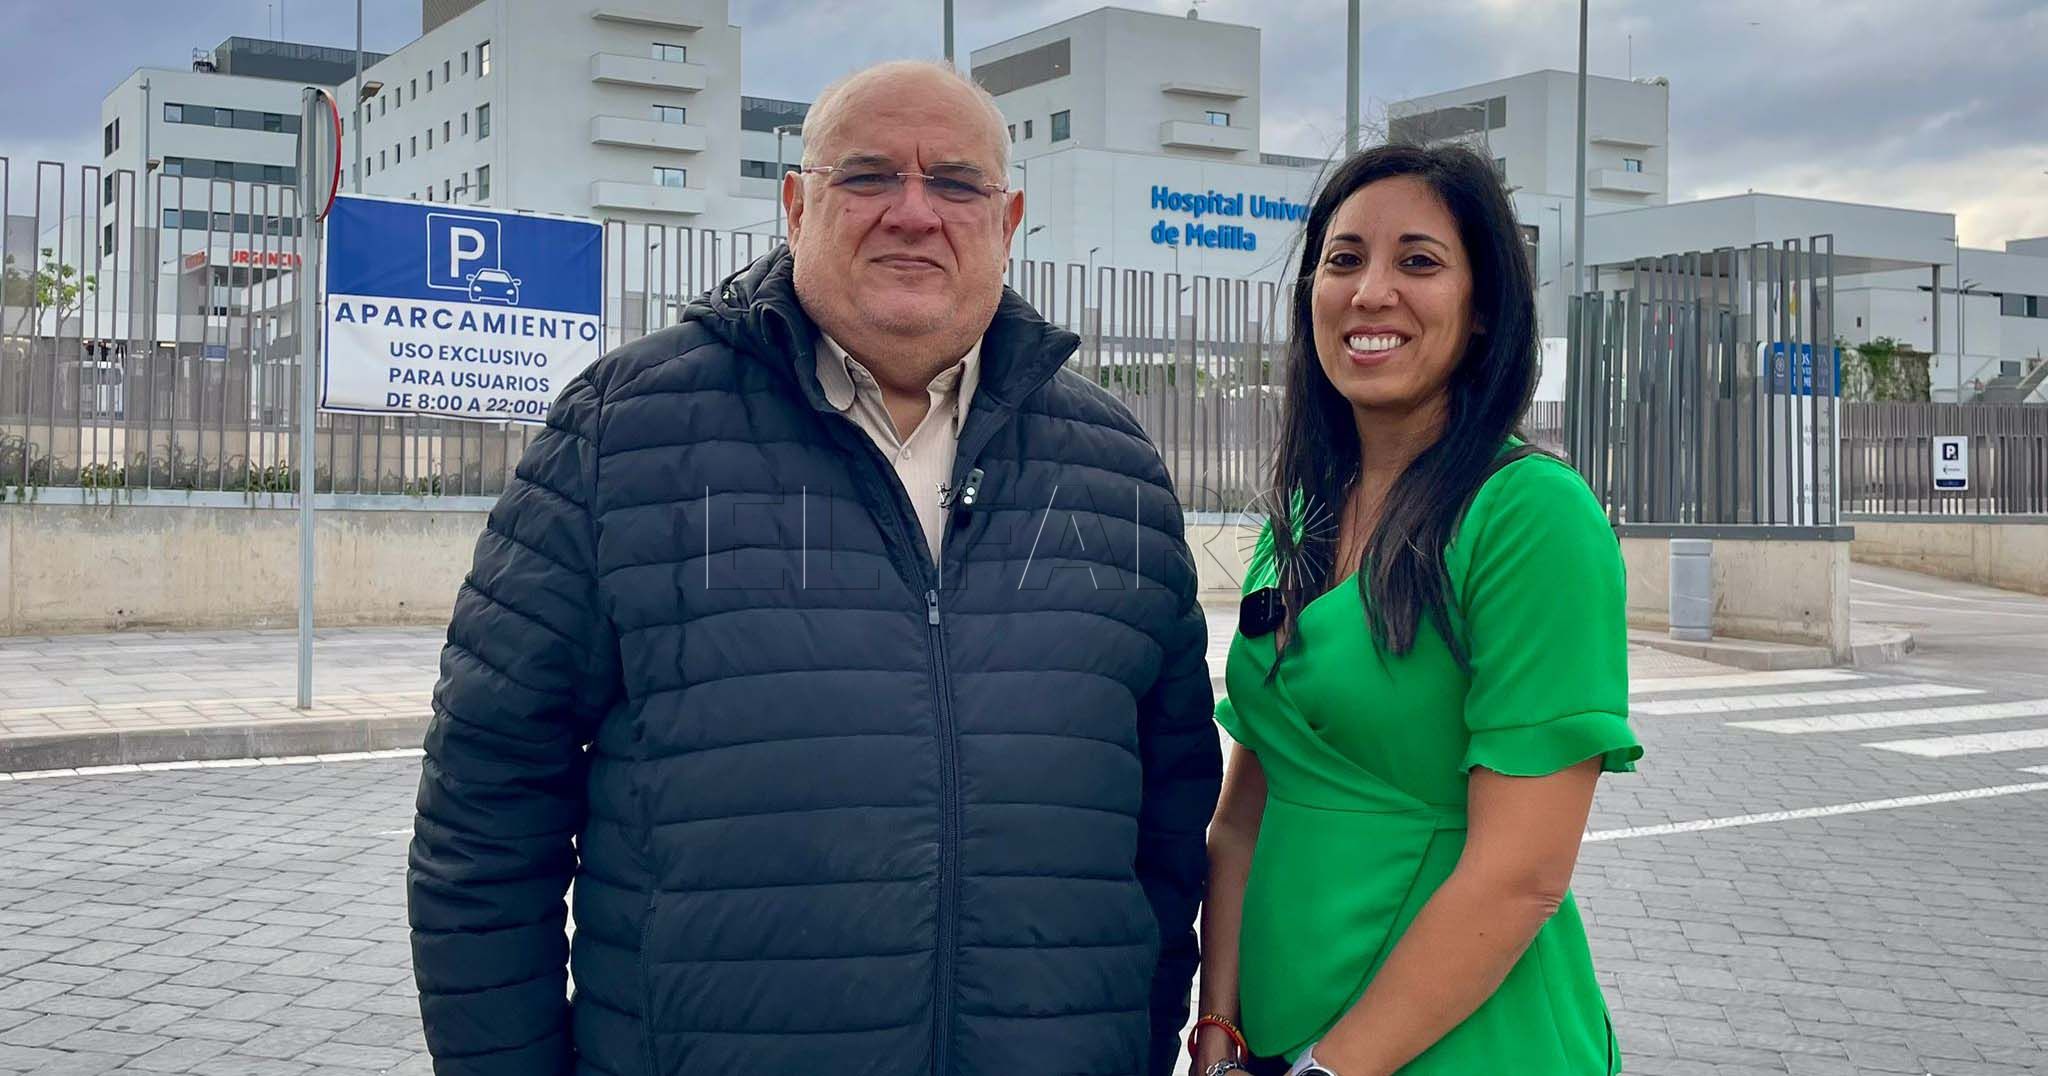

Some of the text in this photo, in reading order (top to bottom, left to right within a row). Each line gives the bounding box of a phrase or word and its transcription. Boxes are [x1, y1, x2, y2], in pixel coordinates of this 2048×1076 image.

[1151, 185, 1244, 218] Hospital
[1151, 220, 1257, 251] de Melilla
[450, 227, 486, 278] P
[334, 302, 598, 342] APARCAMIENTO
[390, 341, 548, 368] USO EXCLUSIVO
[389, 367, 550, 393] PARA USUARIOS
[386, 392, 551, 416] DE 8:00 A 22:00H
